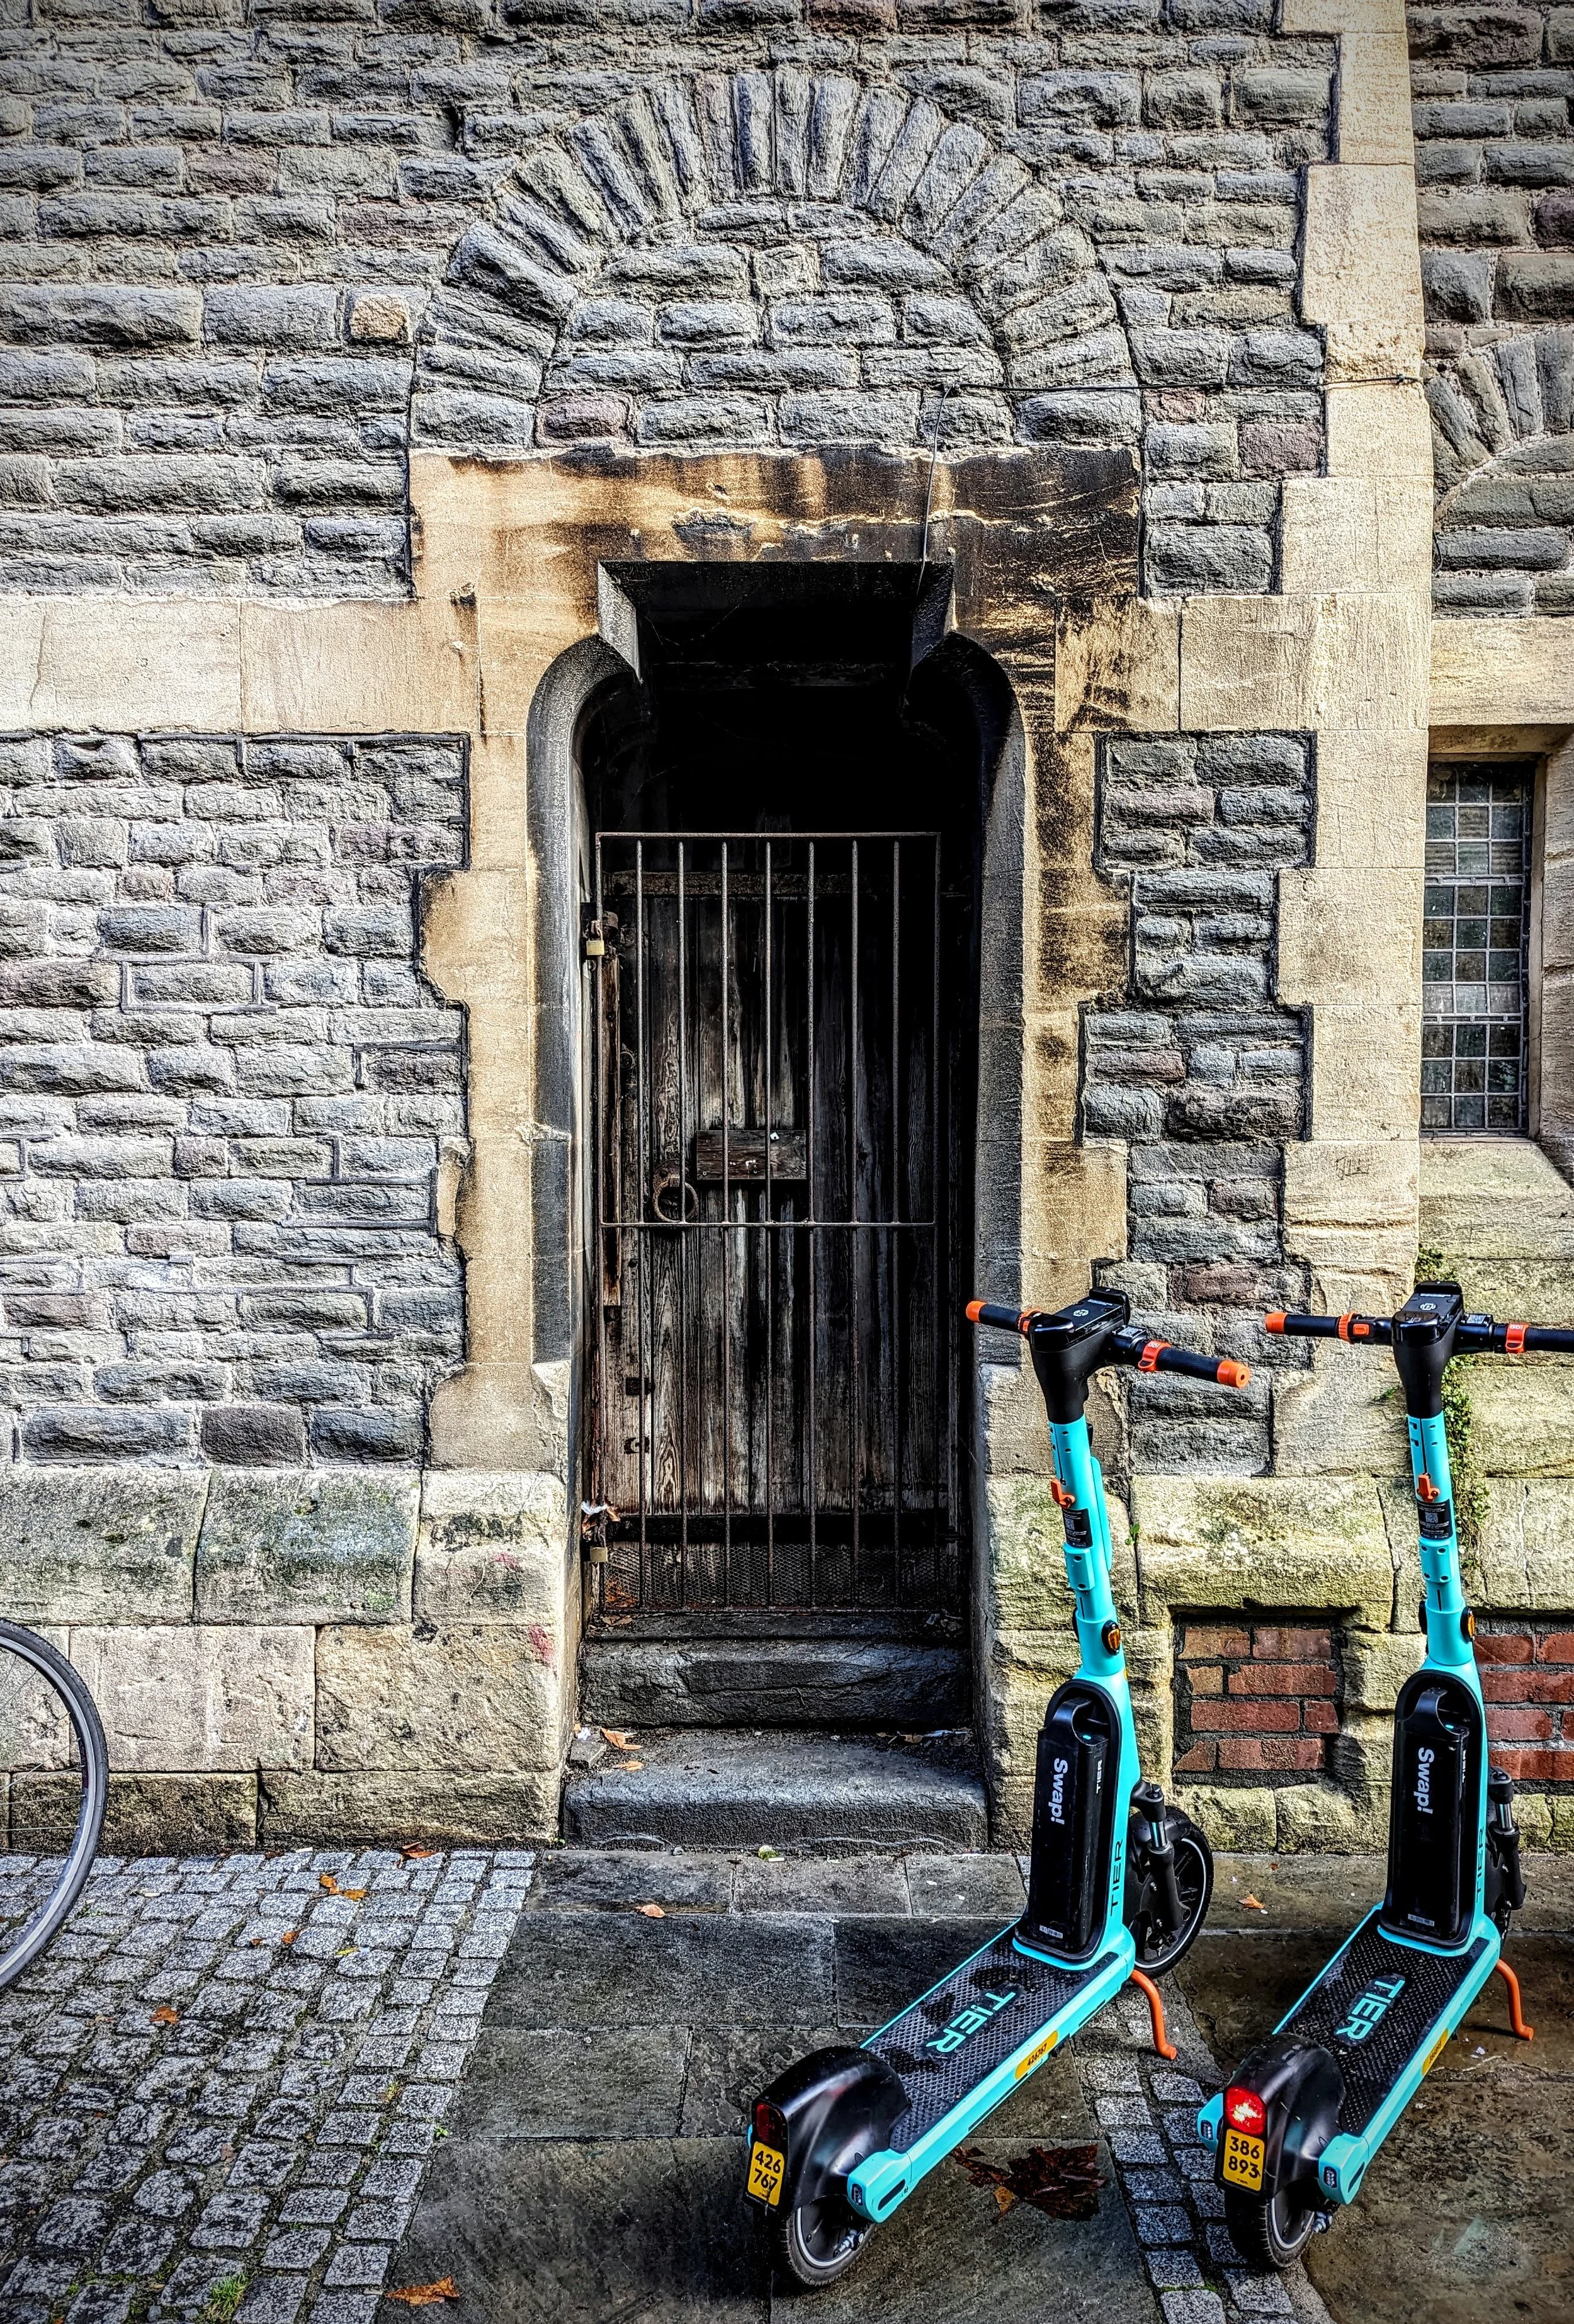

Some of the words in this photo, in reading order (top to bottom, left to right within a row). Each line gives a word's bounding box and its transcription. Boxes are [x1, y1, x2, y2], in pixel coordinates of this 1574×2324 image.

[1048, 1758, 1068, 1825] Swap!
[1413, 1747, 1434, 1815] Swap!
[1111, 1838, 1123, 1917] TIER
[926, 1992, 1016, 2053] TIER
[1336, 1980, 1405, 2039] TIER
[755, 2150, 781, 2174] 426
[1228, 2155, 1259, 2179] 893
[1229, 2136, 1260, 2160] 386
[753, 2167, 778, 2191] 767
